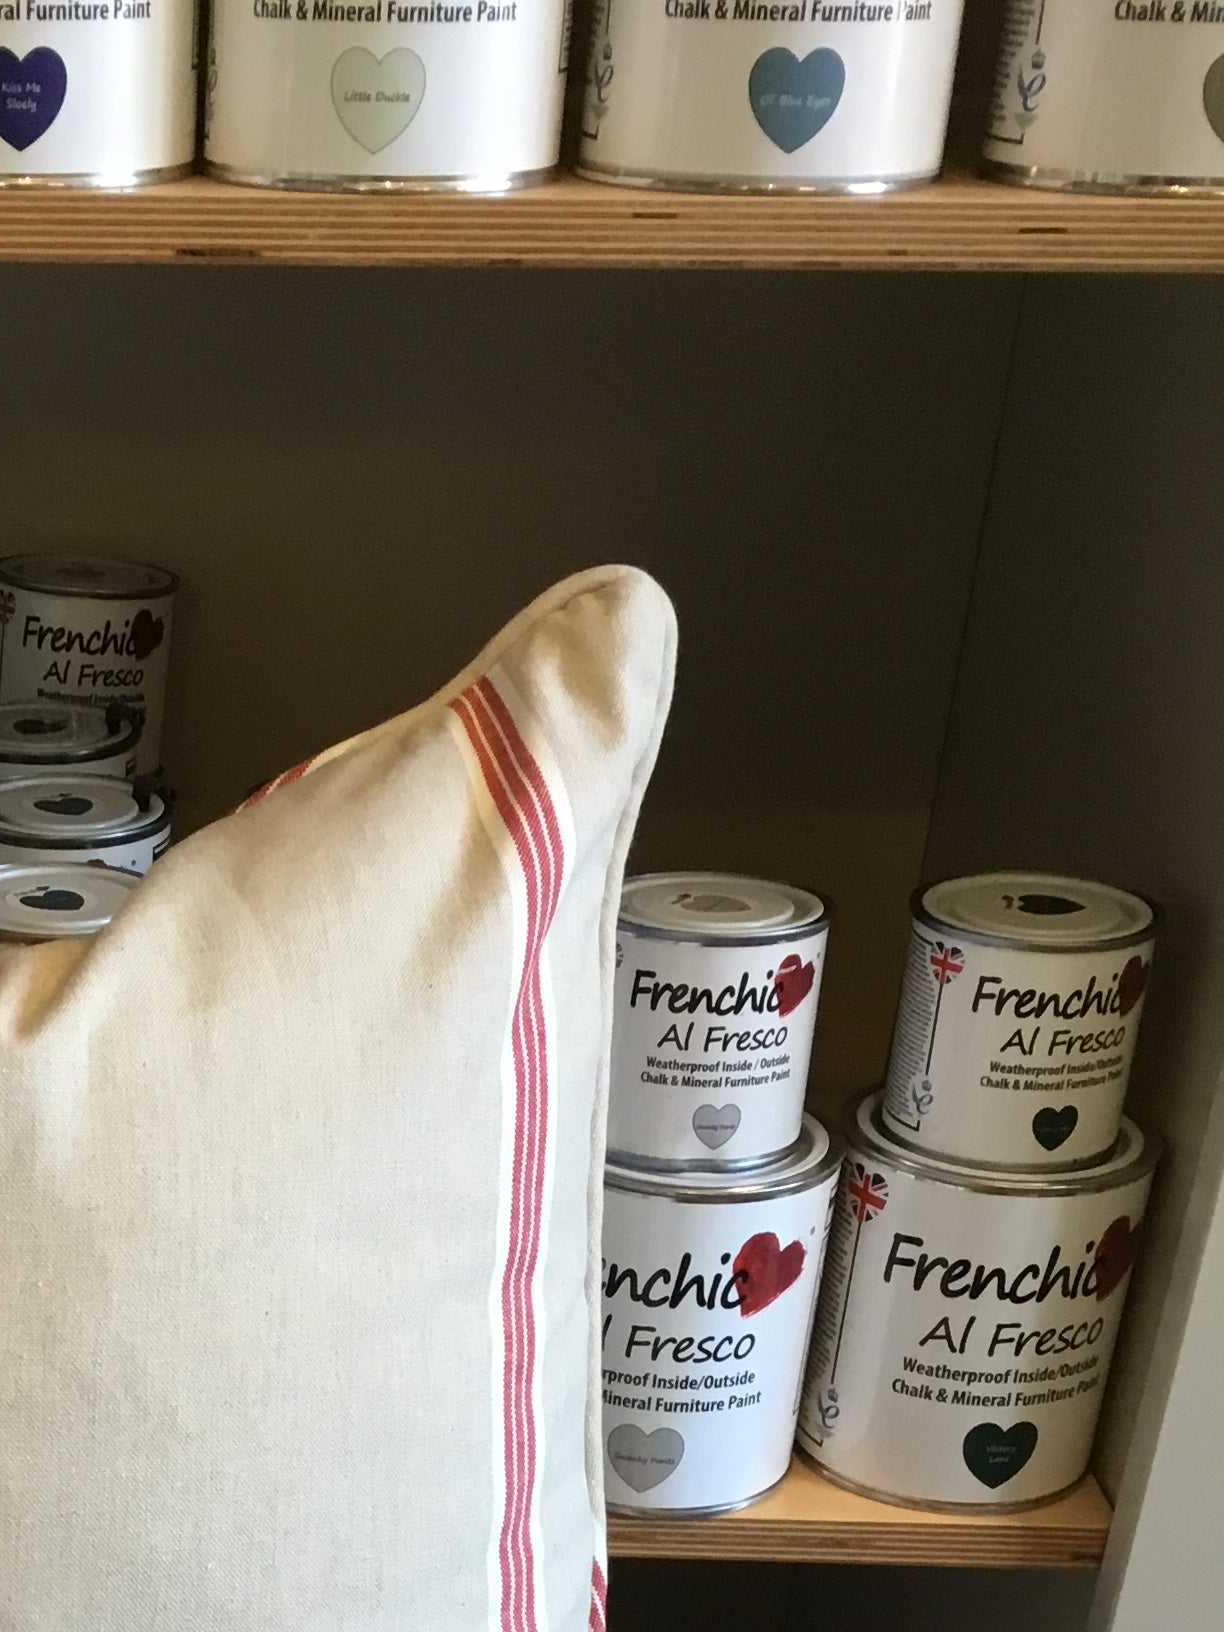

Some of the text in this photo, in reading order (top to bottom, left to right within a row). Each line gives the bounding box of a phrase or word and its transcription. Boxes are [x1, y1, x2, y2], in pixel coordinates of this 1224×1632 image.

[26, 2, 109, 21] Furniture
[113, 0, 151, 20] Paint
[253, 0, 517, 23] Chalk & Mineral Furniture Paint
[665, 0, 710, 19] Chalk
[715, 1, 727, 20] &
[733, 0, 805, 21] Mineral
[811, 1, 892, 22] Furniture
[1115, 0, 1165, 22] Chalk
[1171, 0, 1185, 22] &
[1, 82, 42, 94] Kiss Me
[343, 90, 372, 102] Little
[43, 660, 144, 687] Al Fresco
[630, 969, 785, 1016] Frenchic
[972, 972, 1124, 1020] Frenchic
[657, 1022, 788, 1053] Al Fresco
[1000, 1026, 1126, 1056] Al Fresco
[647, 1056, 720, 1074] Weatherproof
[722, 1060, 753, 1072] Inside
[760, 1053, 791, 1068] Outside
[990, 1061, 1065, 1078] Weatherproof
[641, 1069, 791, 1088] Chalk & Mineral Furniture Paint
[980, 1076, 1009, 1090] Chalk
[1012, 1079, 1020, 1091] &
[1023, 1080, 1064, 1092] Mineral
[883, 1233, 1103, 1304] Frenchic
[602, 1252, 749, 1310] nchic
[625, 1325, 756, 1363] Fresco
[918, 1316, 1104, 1357] Al Fresco
[652, 1371, 756, 1390] Inside/Outside
[903, 1356, 1011, 1386] Weatherproof
[655, 1397, 725, 1413] Furniture
[728, 1391, 763, 1410] Paint
[892, 1378, 933, 1401] Chalk
[936, 1388, 949, 1404] &
[951, 1390, 1011, 1407] Mineral
[1014, 1386, 1075, 1407] Furniture
